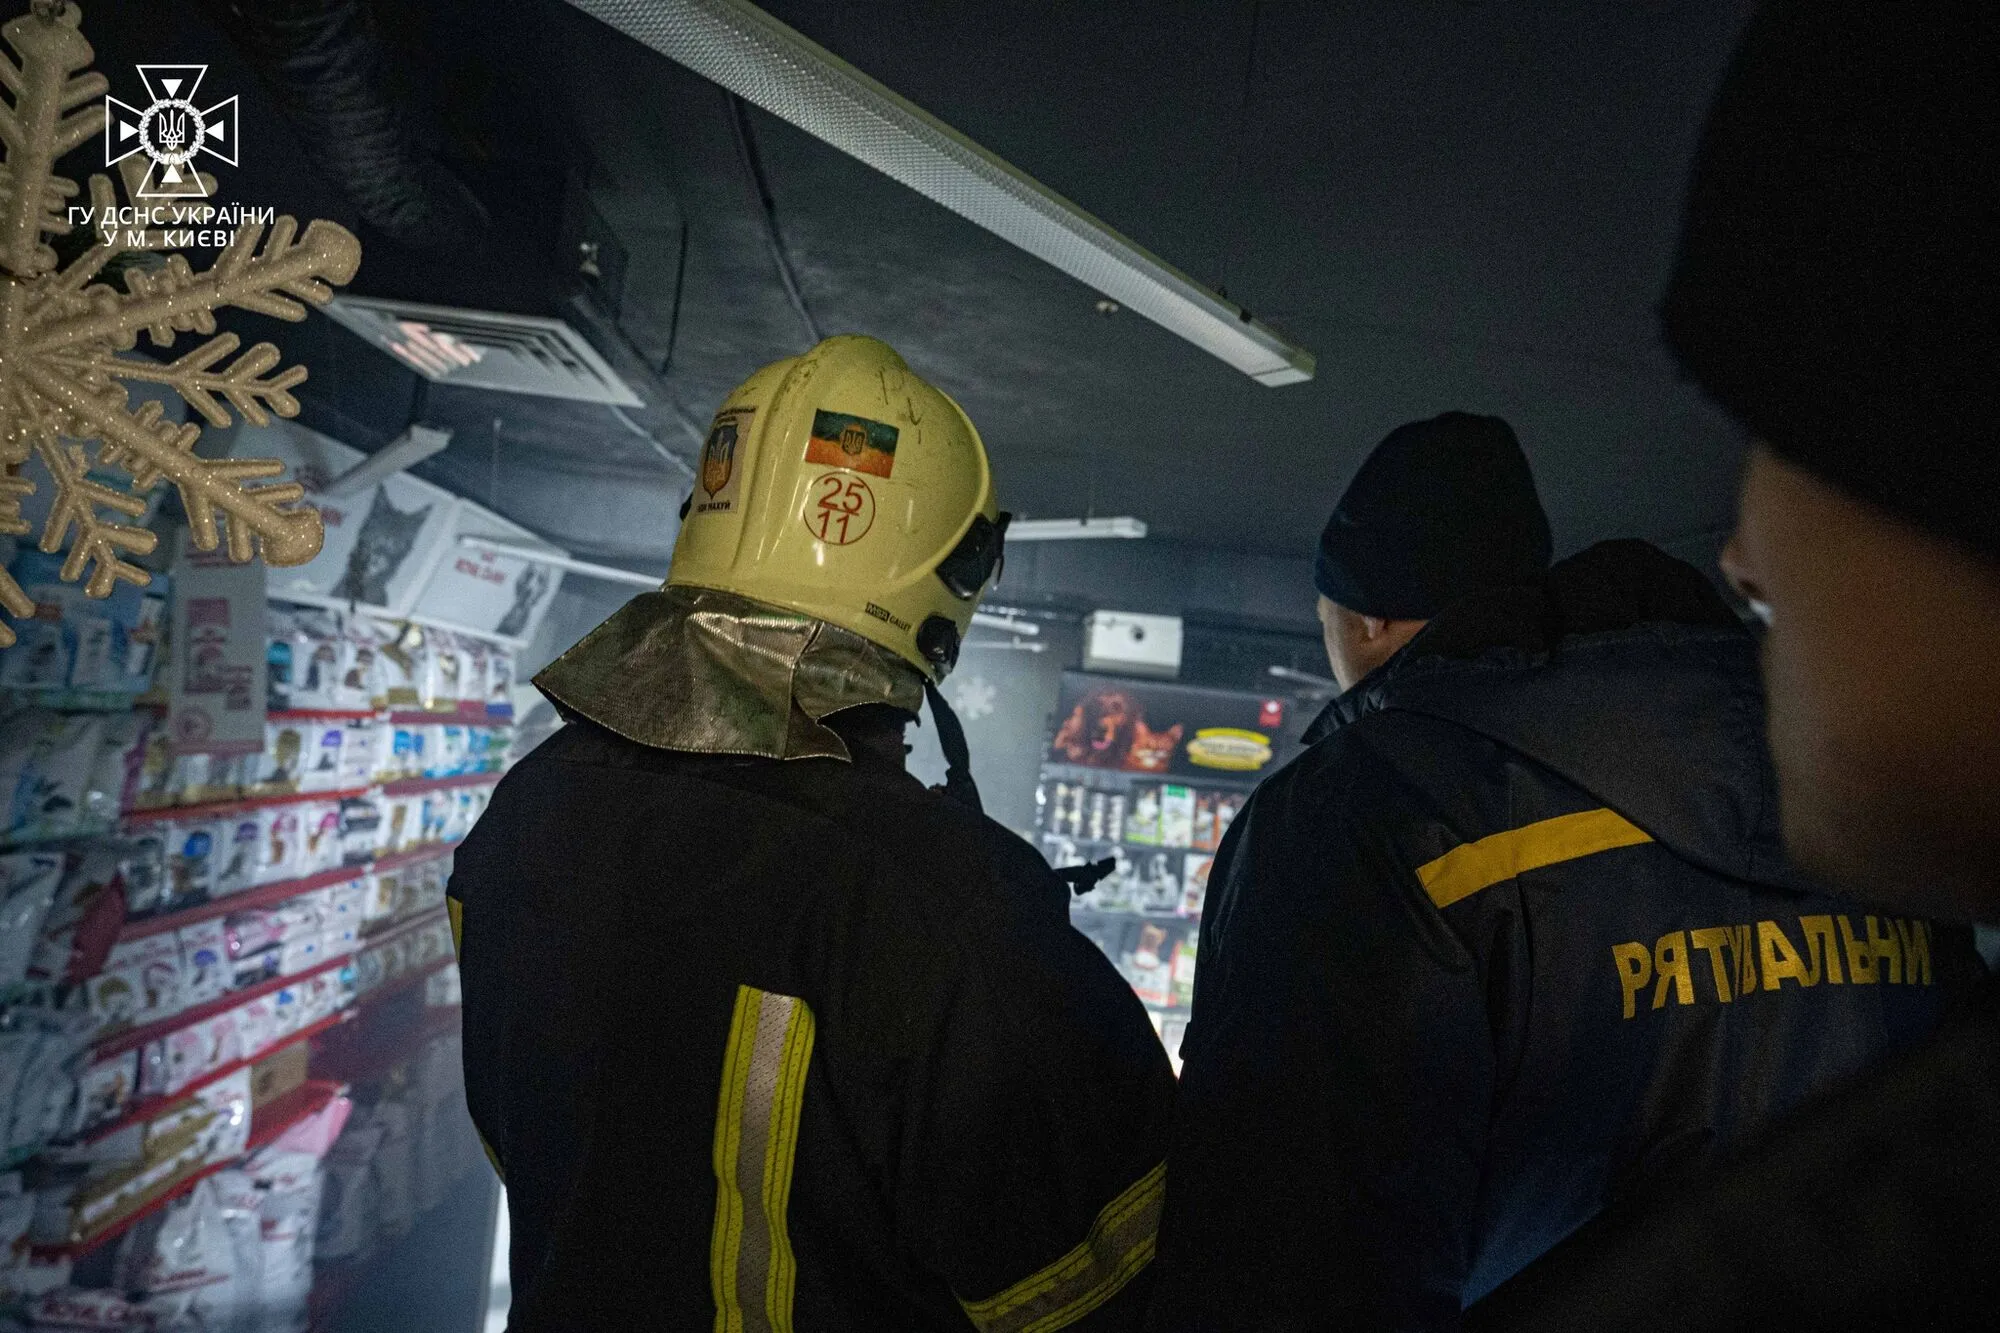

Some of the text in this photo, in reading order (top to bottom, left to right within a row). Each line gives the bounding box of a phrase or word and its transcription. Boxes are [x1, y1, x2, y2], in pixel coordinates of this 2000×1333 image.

[817, 476, 865, 514] 25
[817, 510, 850, 544] 11
[1612, 914, 1933, 1020] РЯТУВАЛЬНИ
